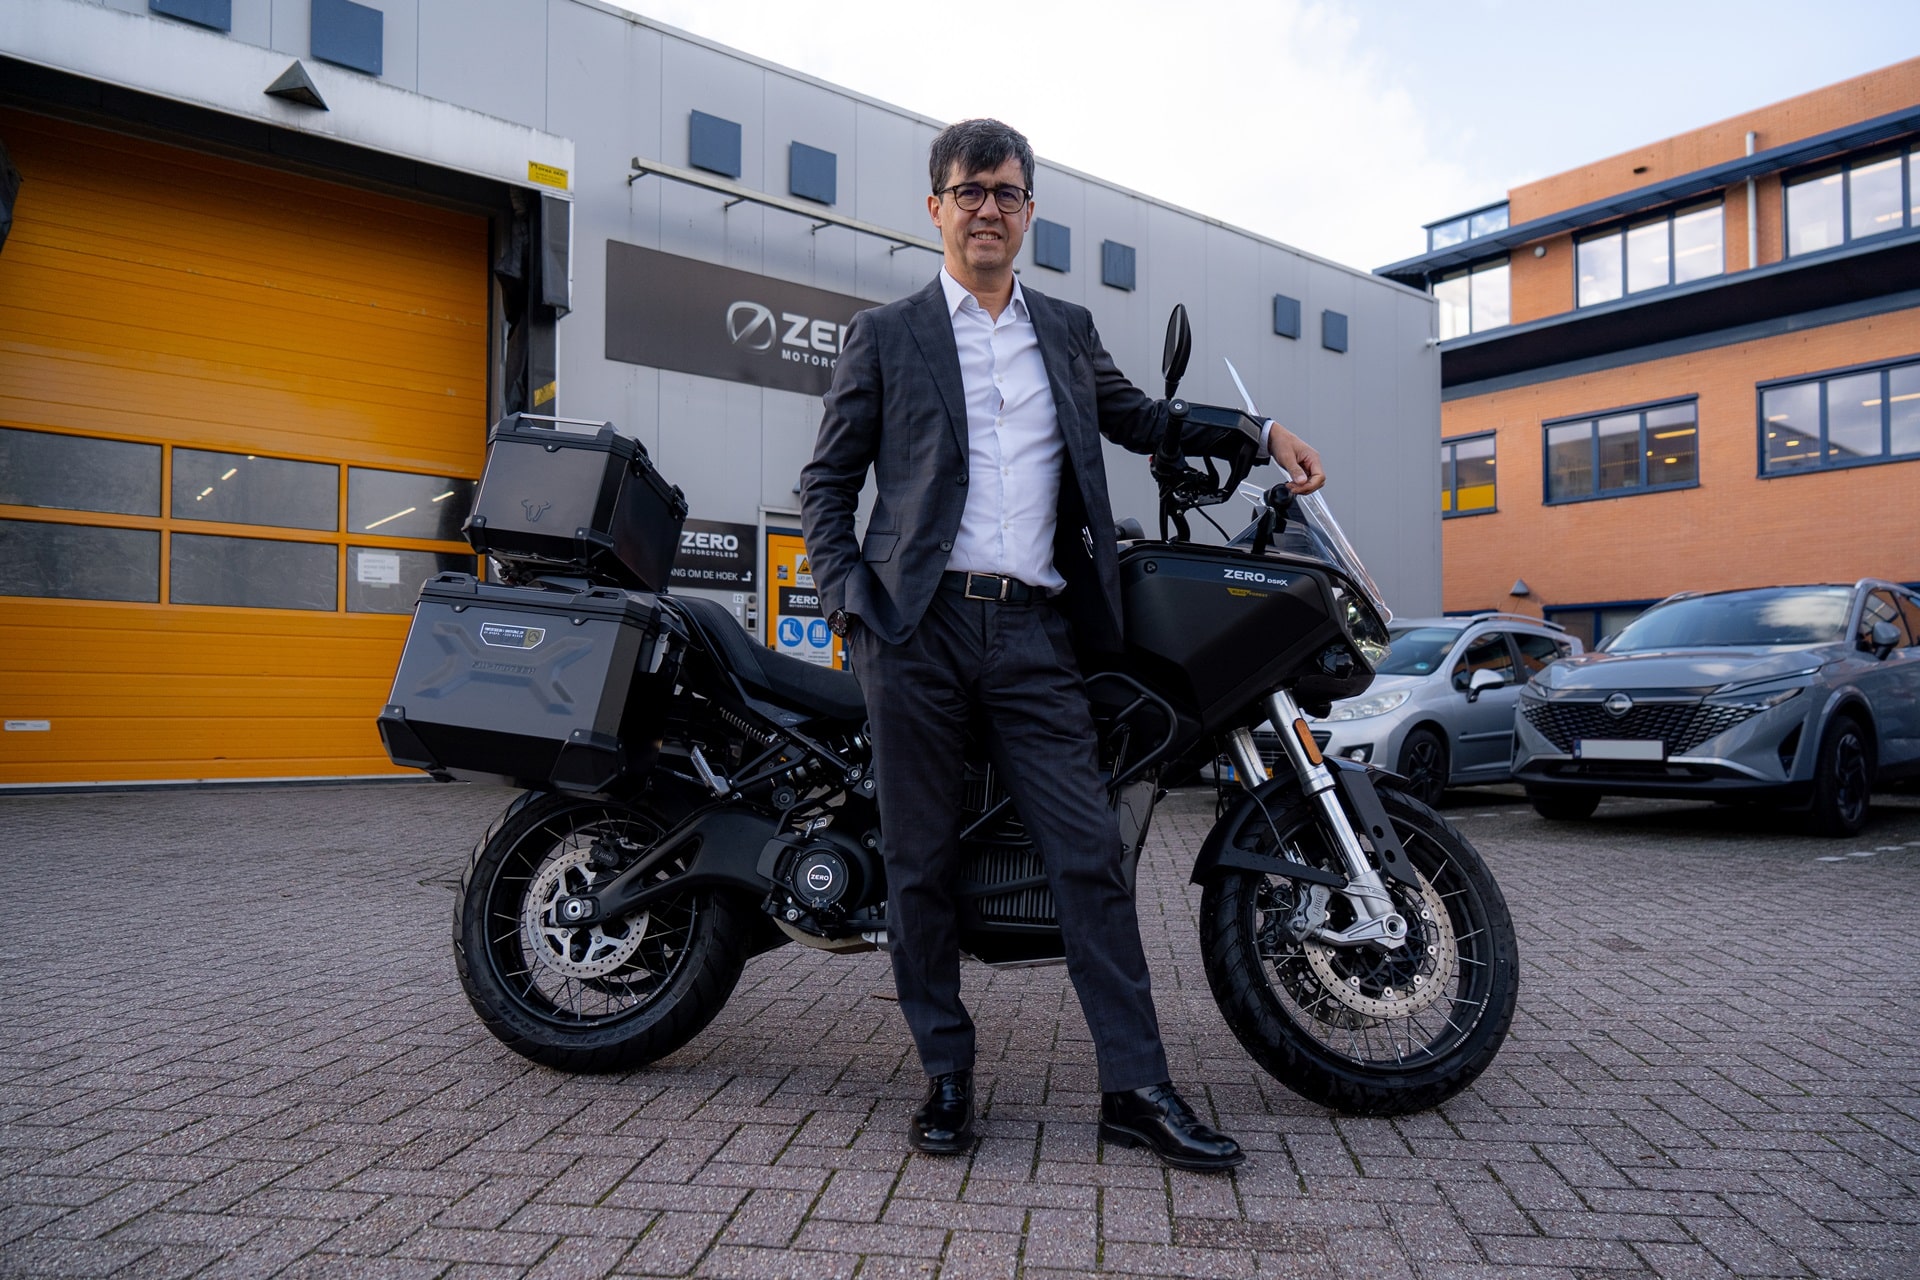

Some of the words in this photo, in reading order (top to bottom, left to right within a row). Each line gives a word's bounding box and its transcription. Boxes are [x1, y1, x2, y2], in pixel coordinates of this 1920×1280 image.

[681, 531, 738, 551] ZERO
[687, 569, 701, 578] OM
[703, 570, 714, 579] DE
[716, 571, 738, 581] HOEK
[1223, 568, 1265, 582] ZERO
[788, 594, 819, 605] ZERO
